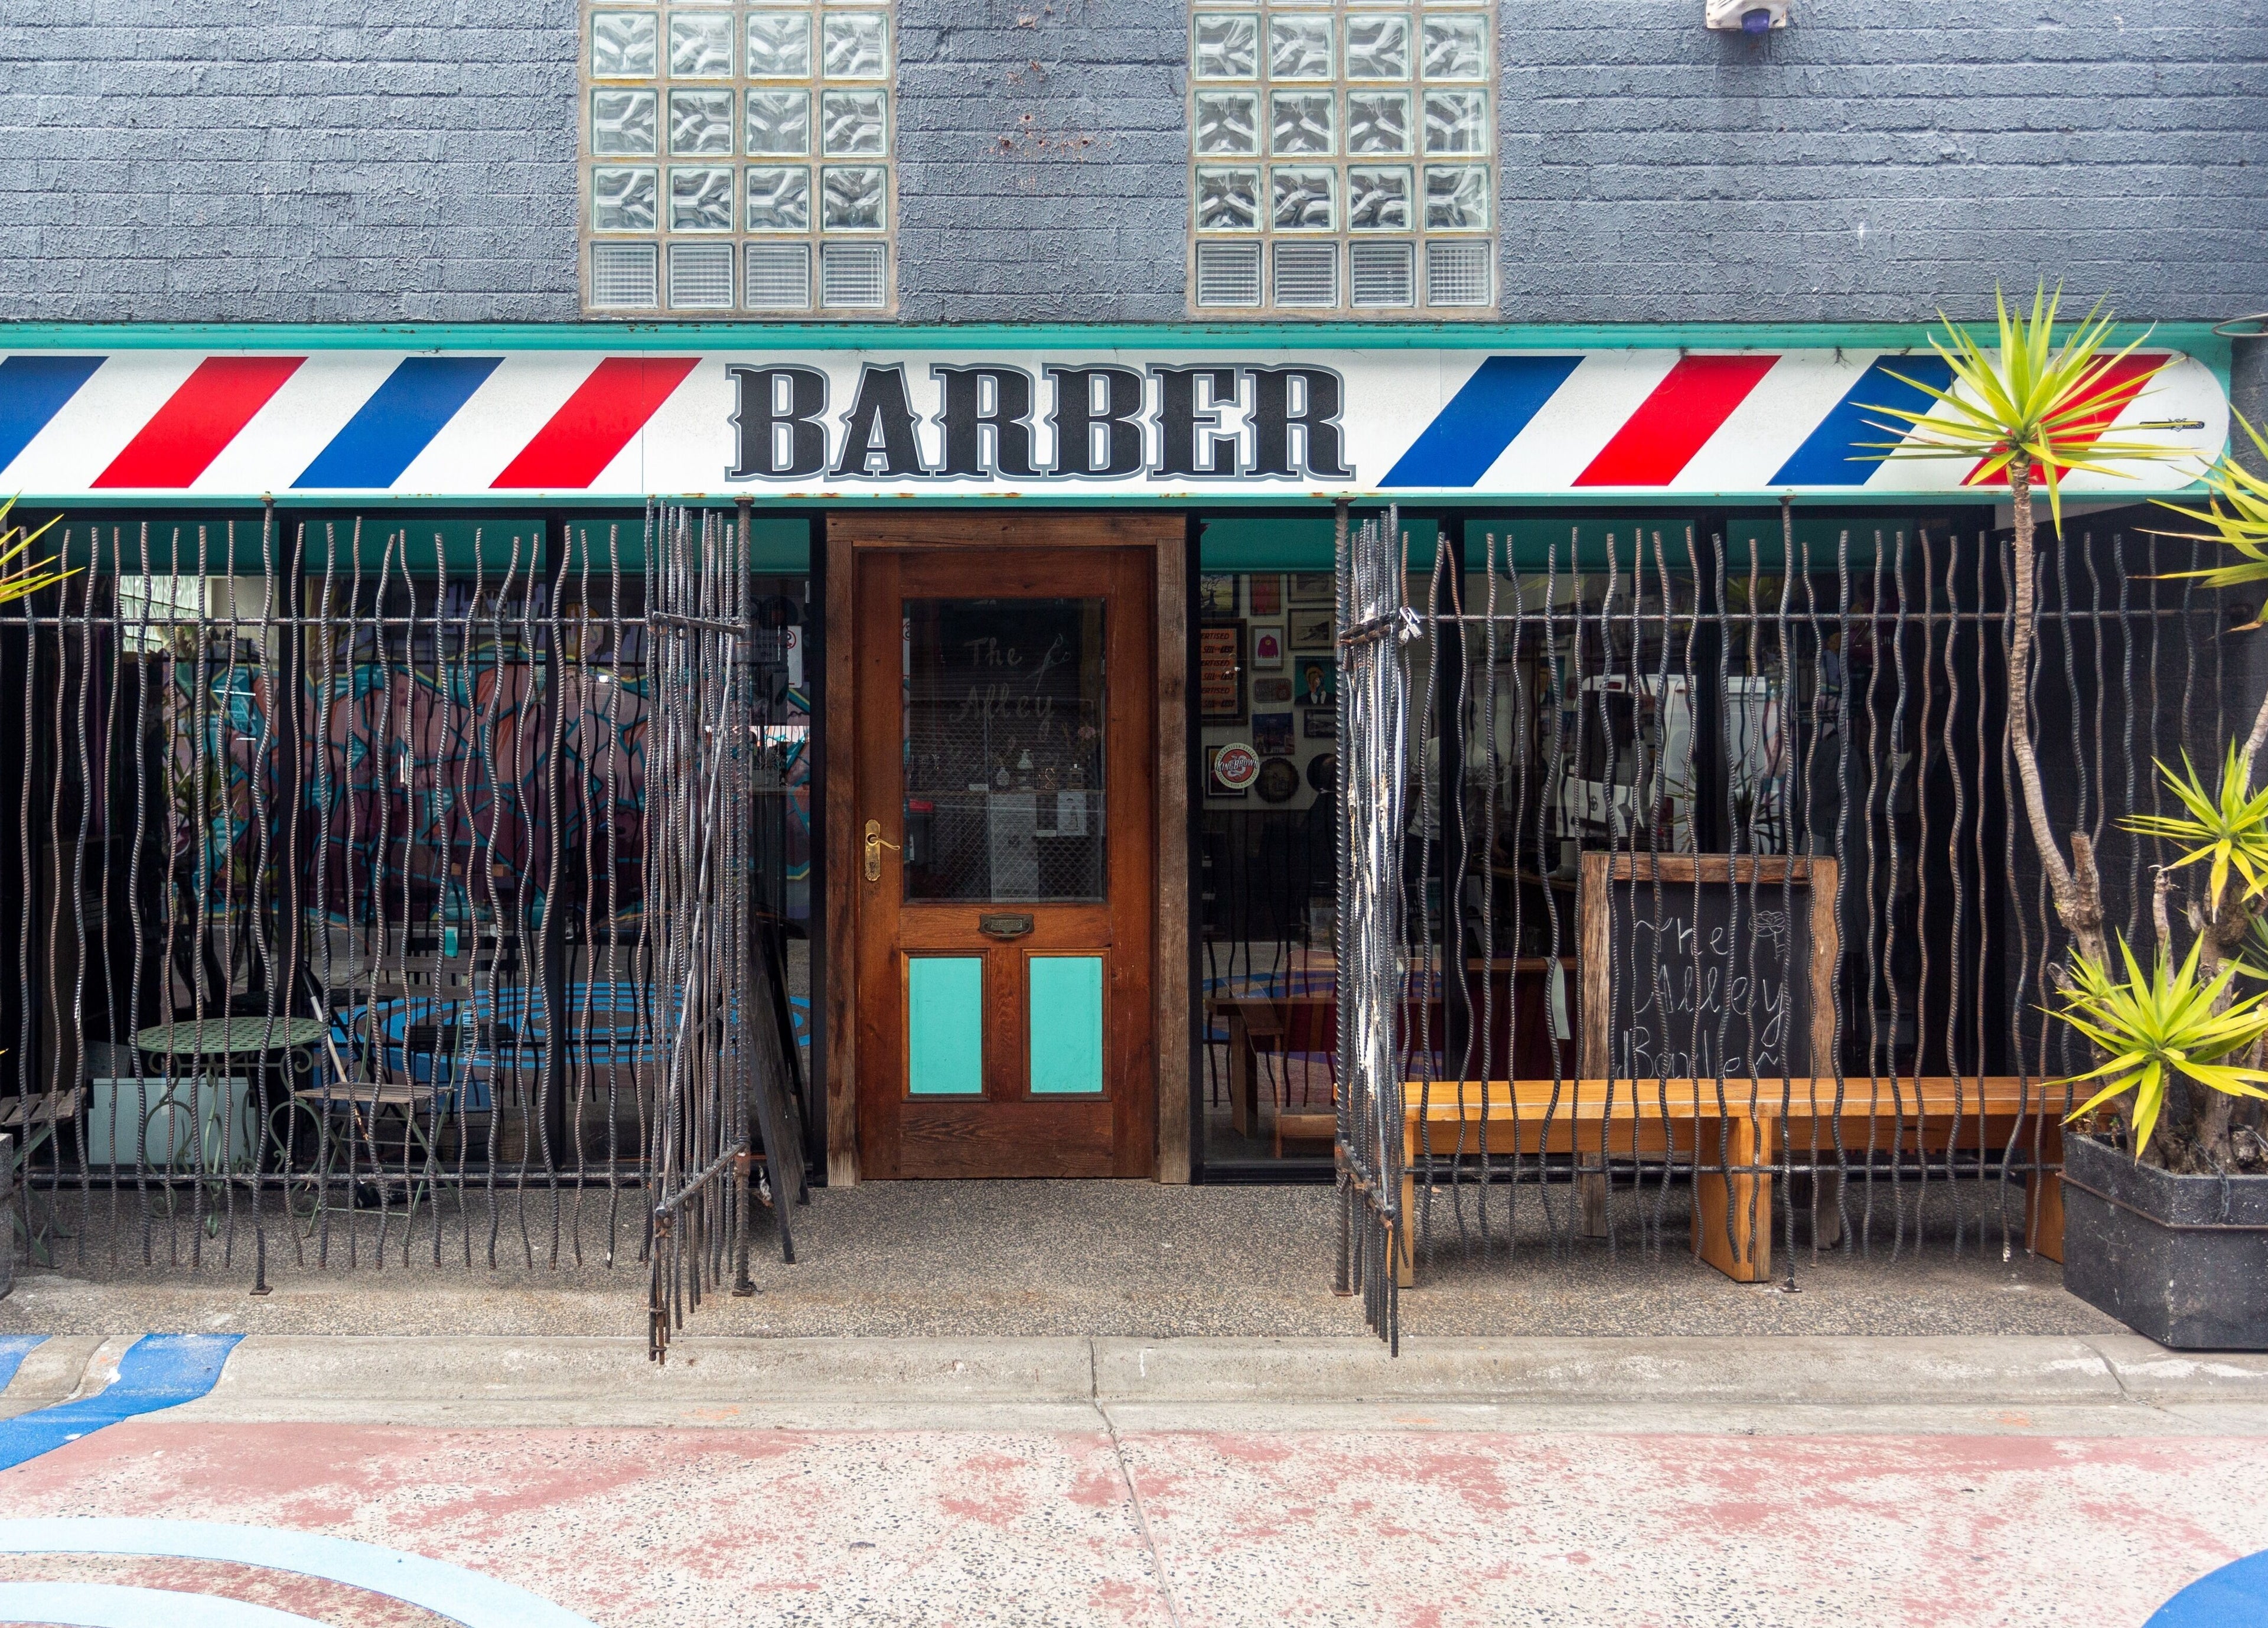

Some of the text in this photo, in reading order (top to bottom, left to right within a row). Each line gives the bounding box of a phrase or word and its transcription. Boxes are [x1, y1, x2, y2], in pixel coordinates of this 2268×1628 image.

[725, 362, 1356, 482] BARBER
[964, 636, 1024, 668] The
[949, 682, 1055, 741] Alley
[1634, 917, 1728, 955] The
[1635, 964, 1791, 1047] Alley
